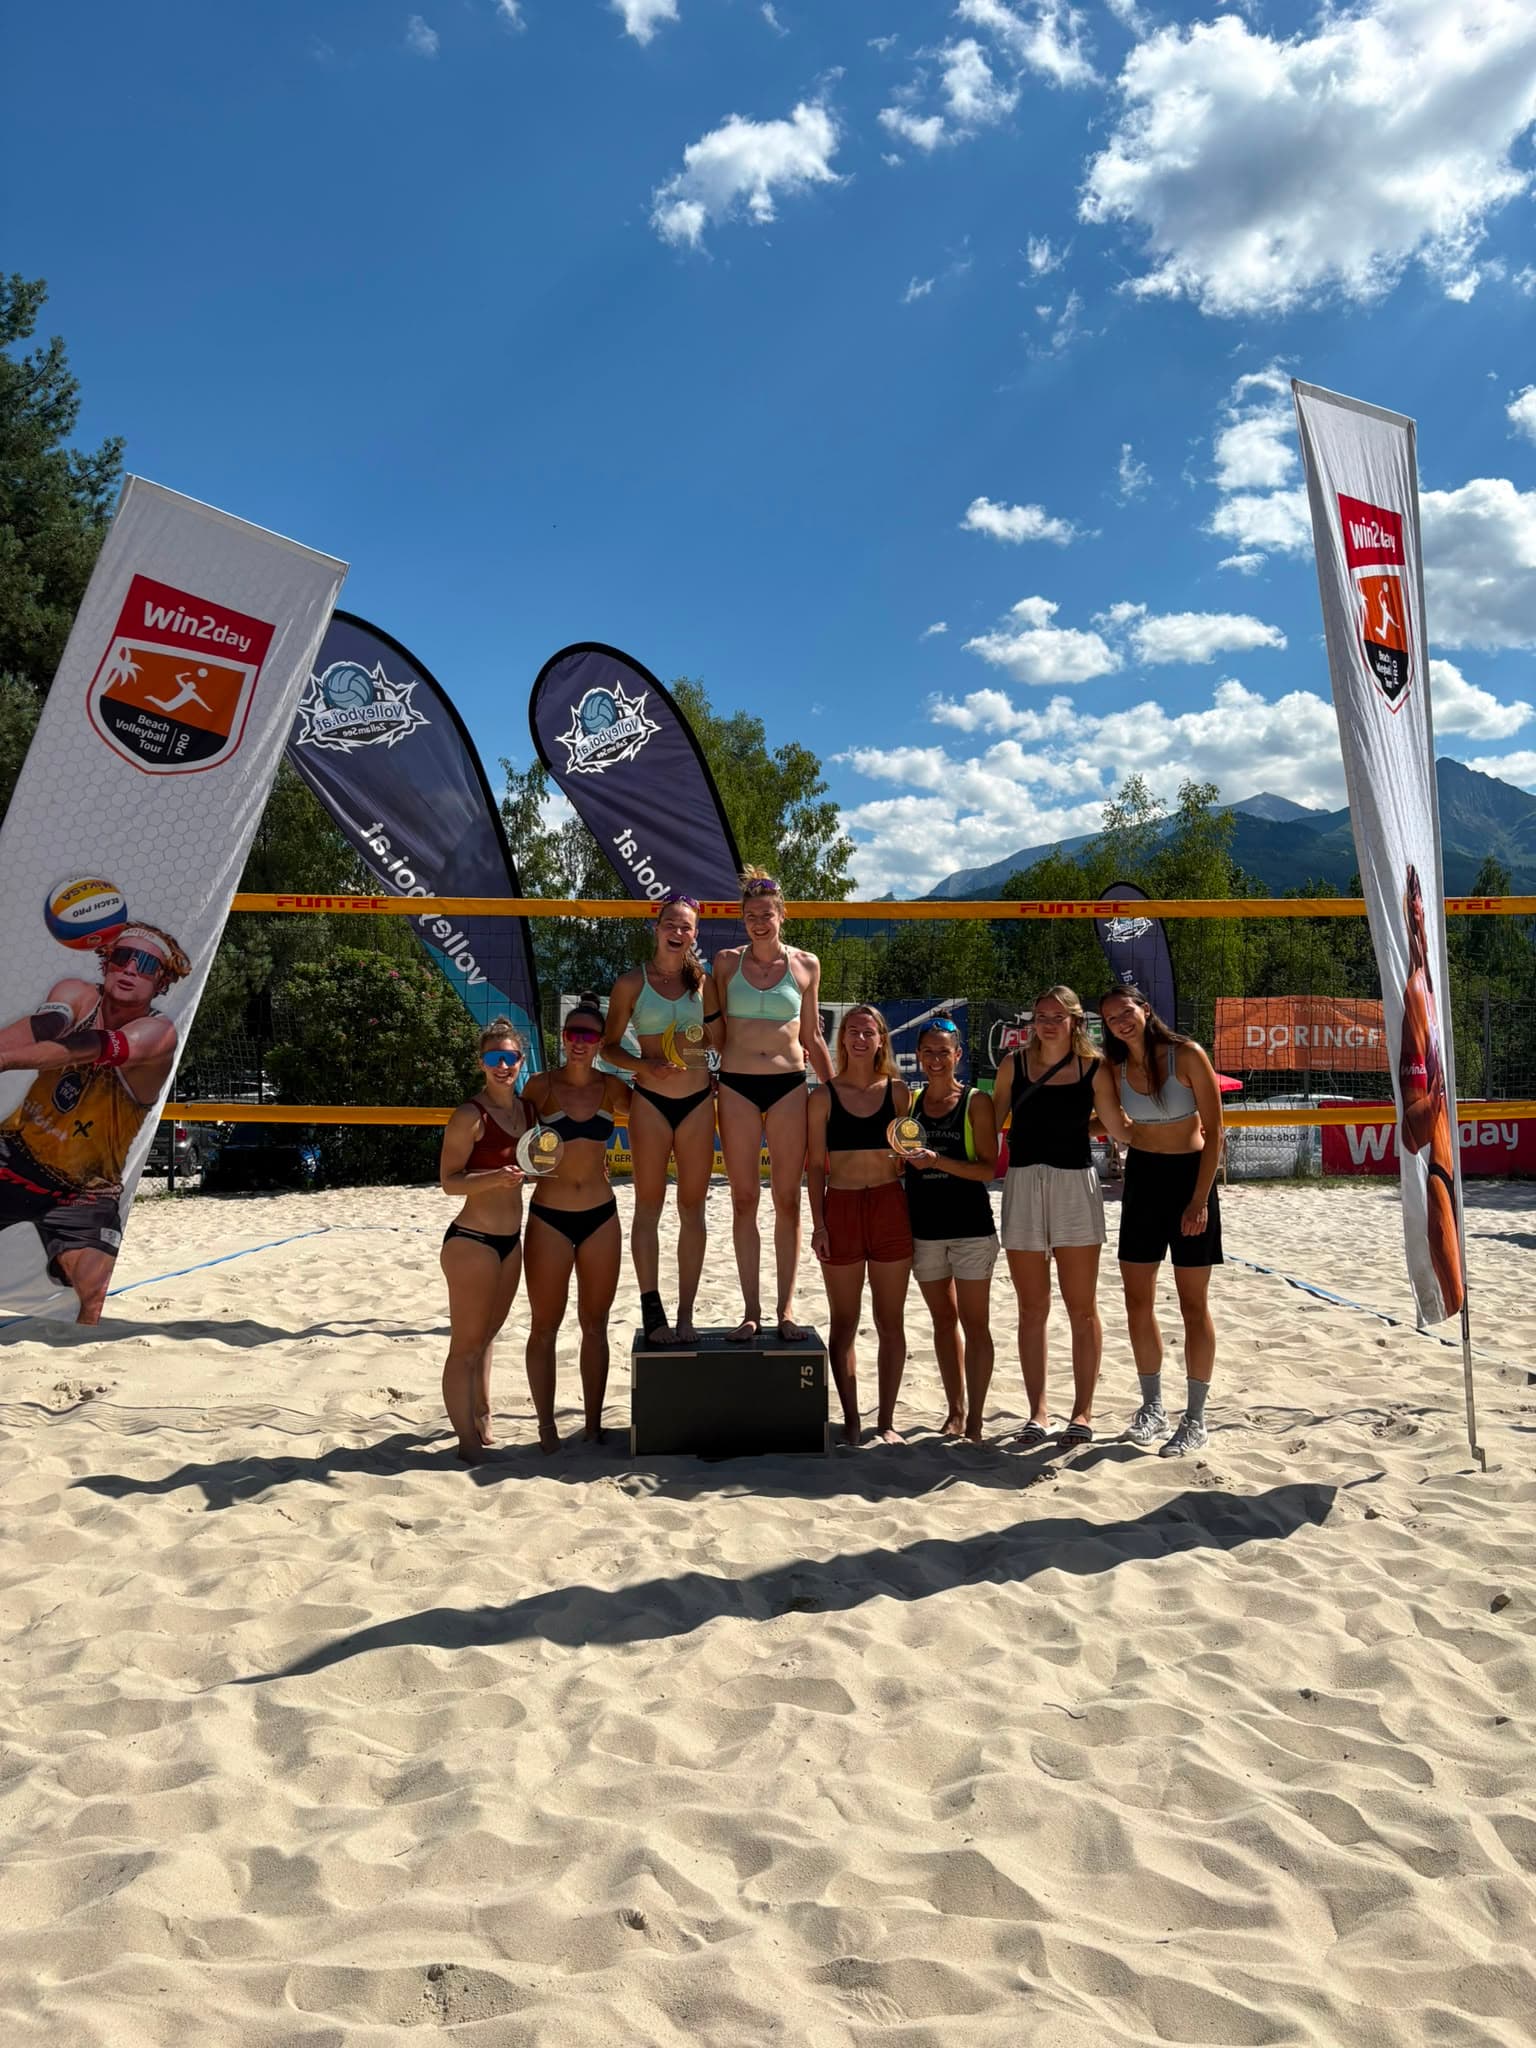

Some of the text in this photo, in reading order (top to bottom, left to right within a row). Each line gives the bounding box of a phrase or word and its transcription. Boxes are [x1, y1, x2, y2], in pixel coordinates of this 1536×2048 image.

[144, 601, 252, 652] win2day
[115, 718, 167, 743] Volleyball
[137, 714, 170, 733] Beach
[139, 739, 163, 753] Tour
[174, 733, 190, 756] PRO
[72, 906, 92, 918] PRO
[277, 897, 389, 910] FUNTEC
[1021, 903, 1130, 914] FUNTEC
[1345, 1120, 1518, 1165] wday
[801, 1365, 814, 1388] 75
